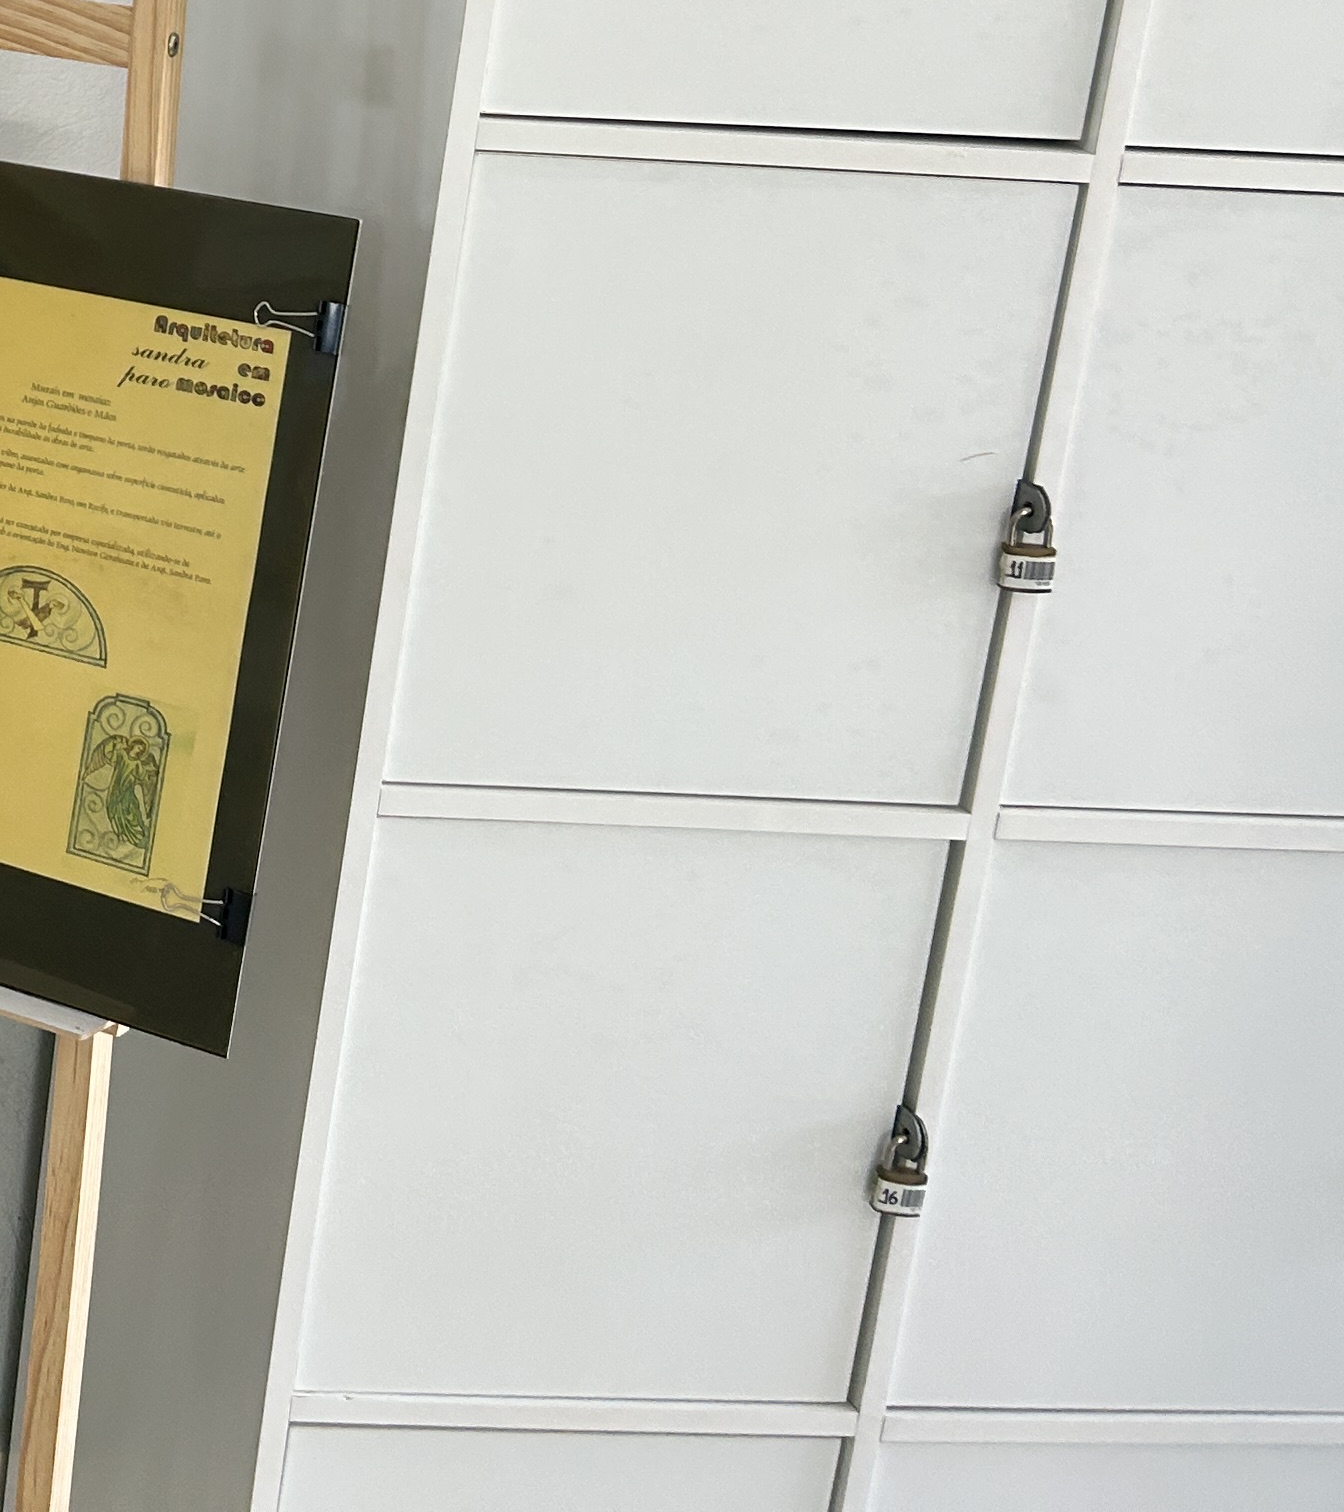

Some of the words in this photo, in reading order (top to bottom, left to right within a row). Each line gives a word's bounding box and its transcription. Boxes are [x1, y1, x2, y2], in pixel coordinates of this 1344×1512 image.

[154, 315, 275, 355] Arquitetura
[131, 345, 208, 370] sandra
[237, 361, 271, 381] em
[117, 364, 172, 389] paro
[174, 375, 266, 407] mosaico
